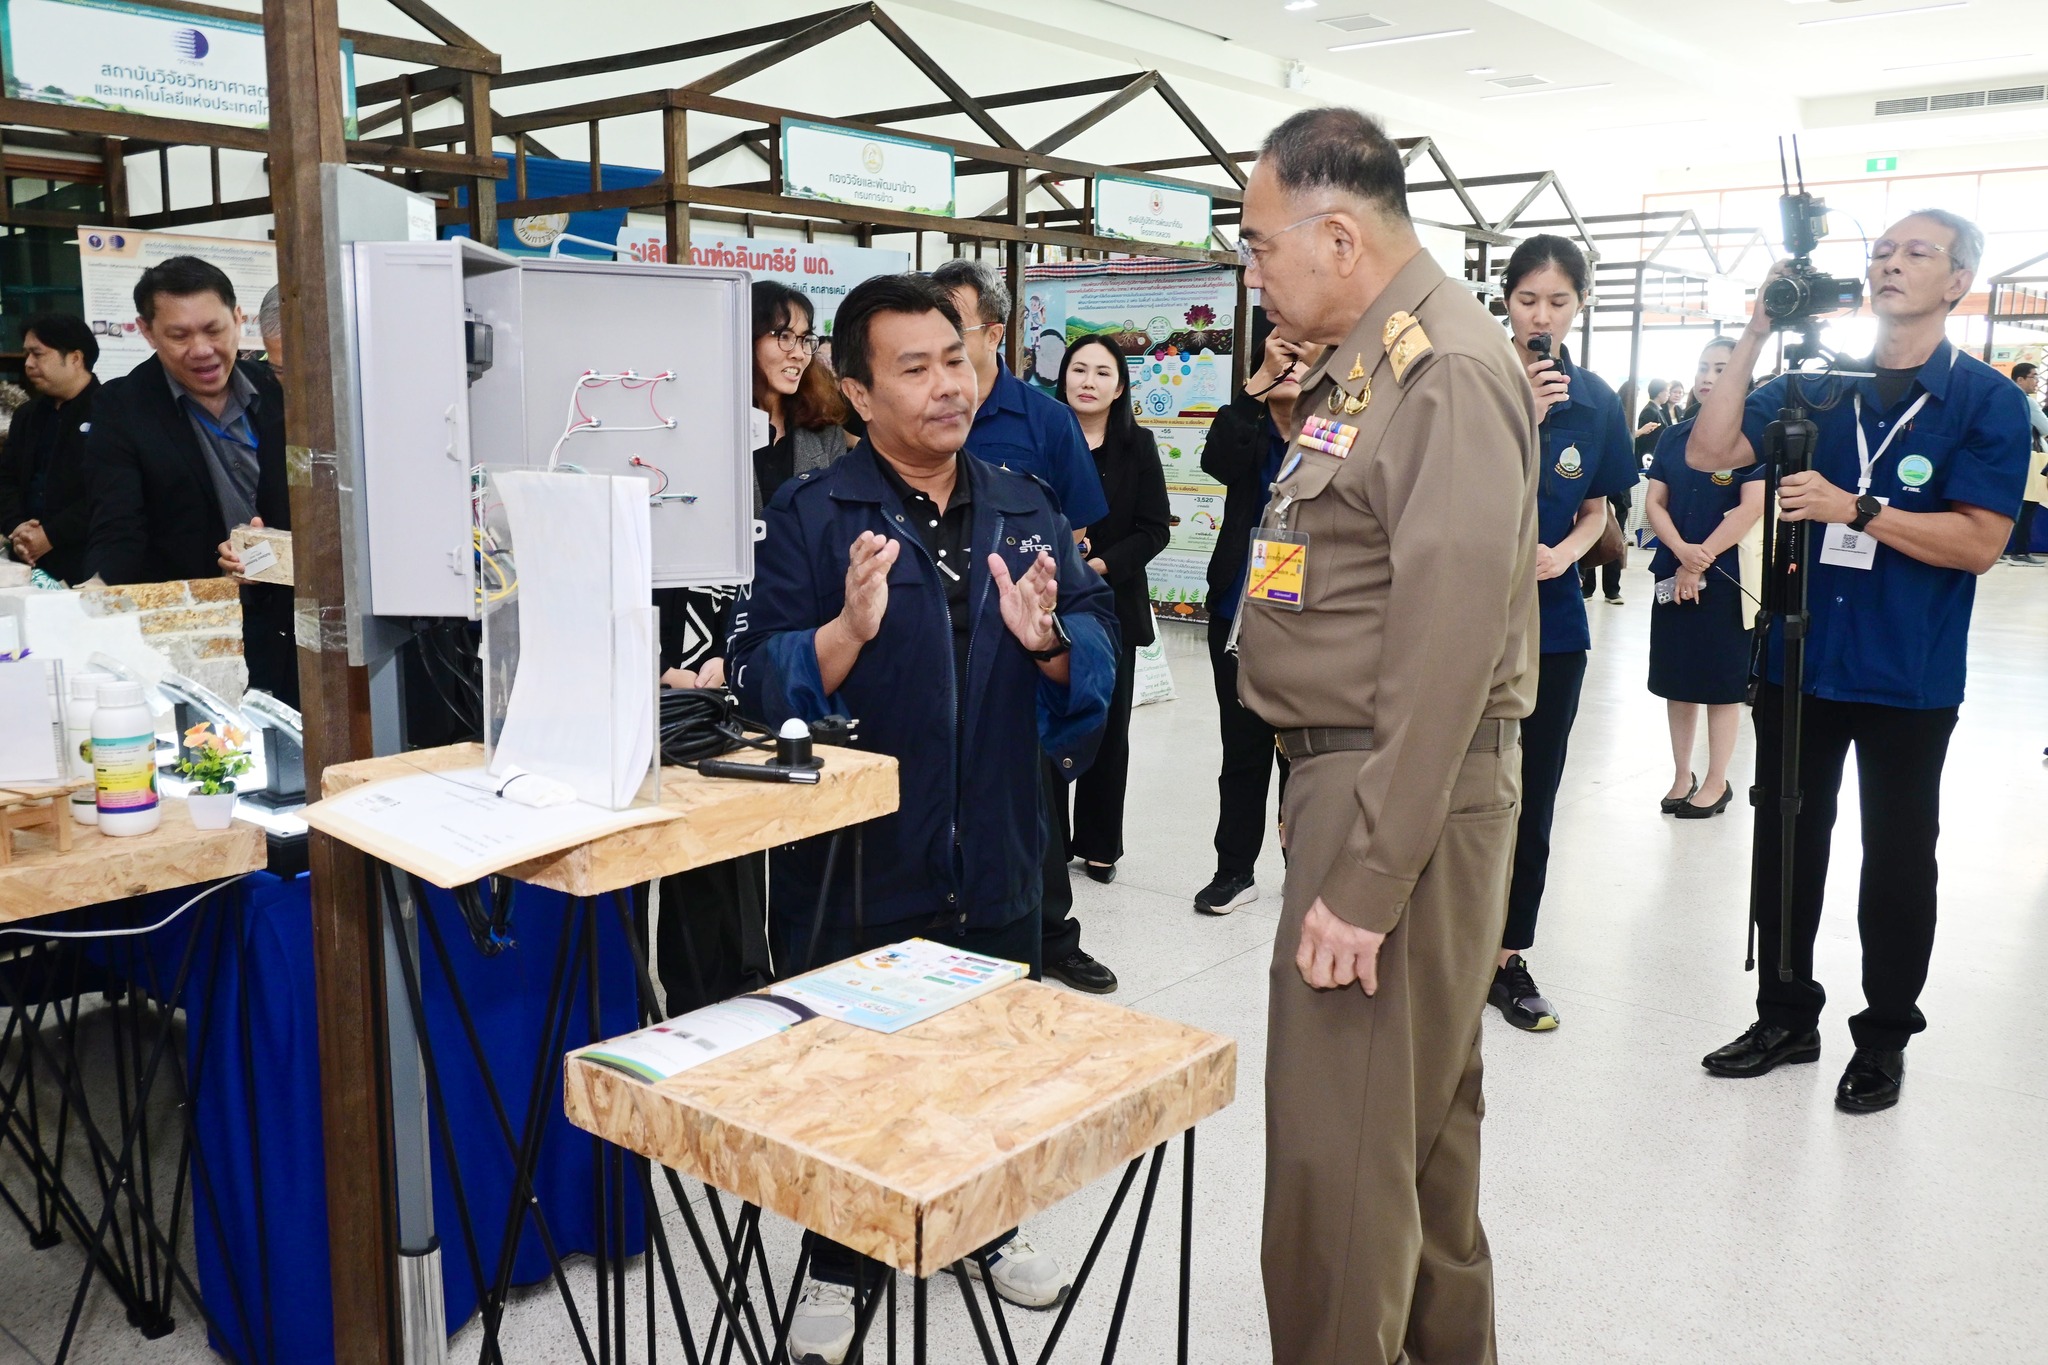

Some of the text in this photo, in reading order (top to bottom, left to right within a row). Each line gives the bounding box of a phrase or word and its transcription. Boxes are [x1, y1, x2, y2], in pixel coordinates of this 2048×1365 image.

[828, 172, 917, 195] กองวิจัยและพัฒนาข้าว
[853, 190, 894, 204] กรมการข้าว
[803, 255, 835, 276] พด.
[810, 284, 846, 296] ลดสารเคมี
